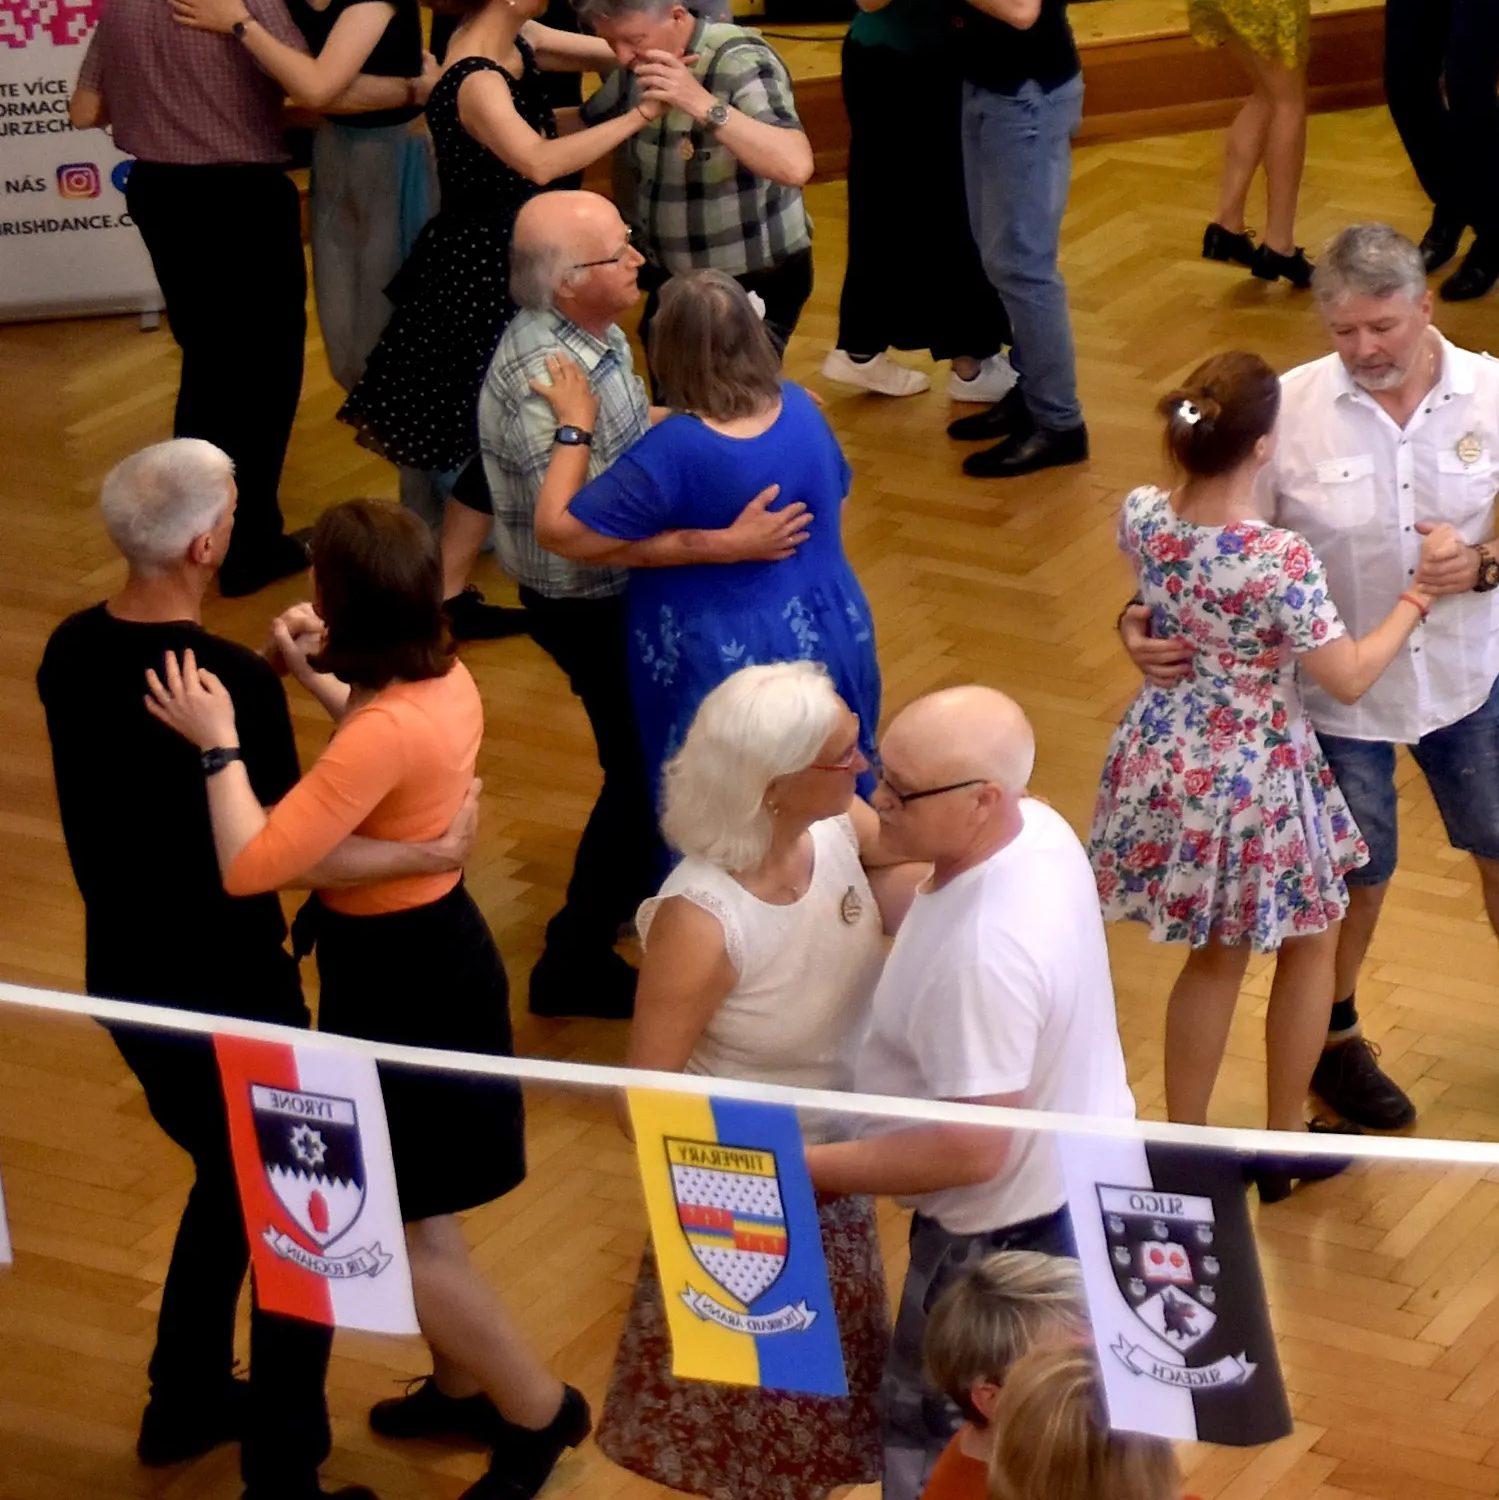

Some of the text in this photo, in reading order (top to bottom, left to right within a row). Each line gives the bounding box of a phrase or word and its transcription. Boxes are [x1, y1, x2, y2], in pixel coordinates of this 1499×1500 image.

[24, 77, 69, 95] VÍCE
[0, 119, 73, 137] URZECH
[5, 175, 47, 194] NÁS
